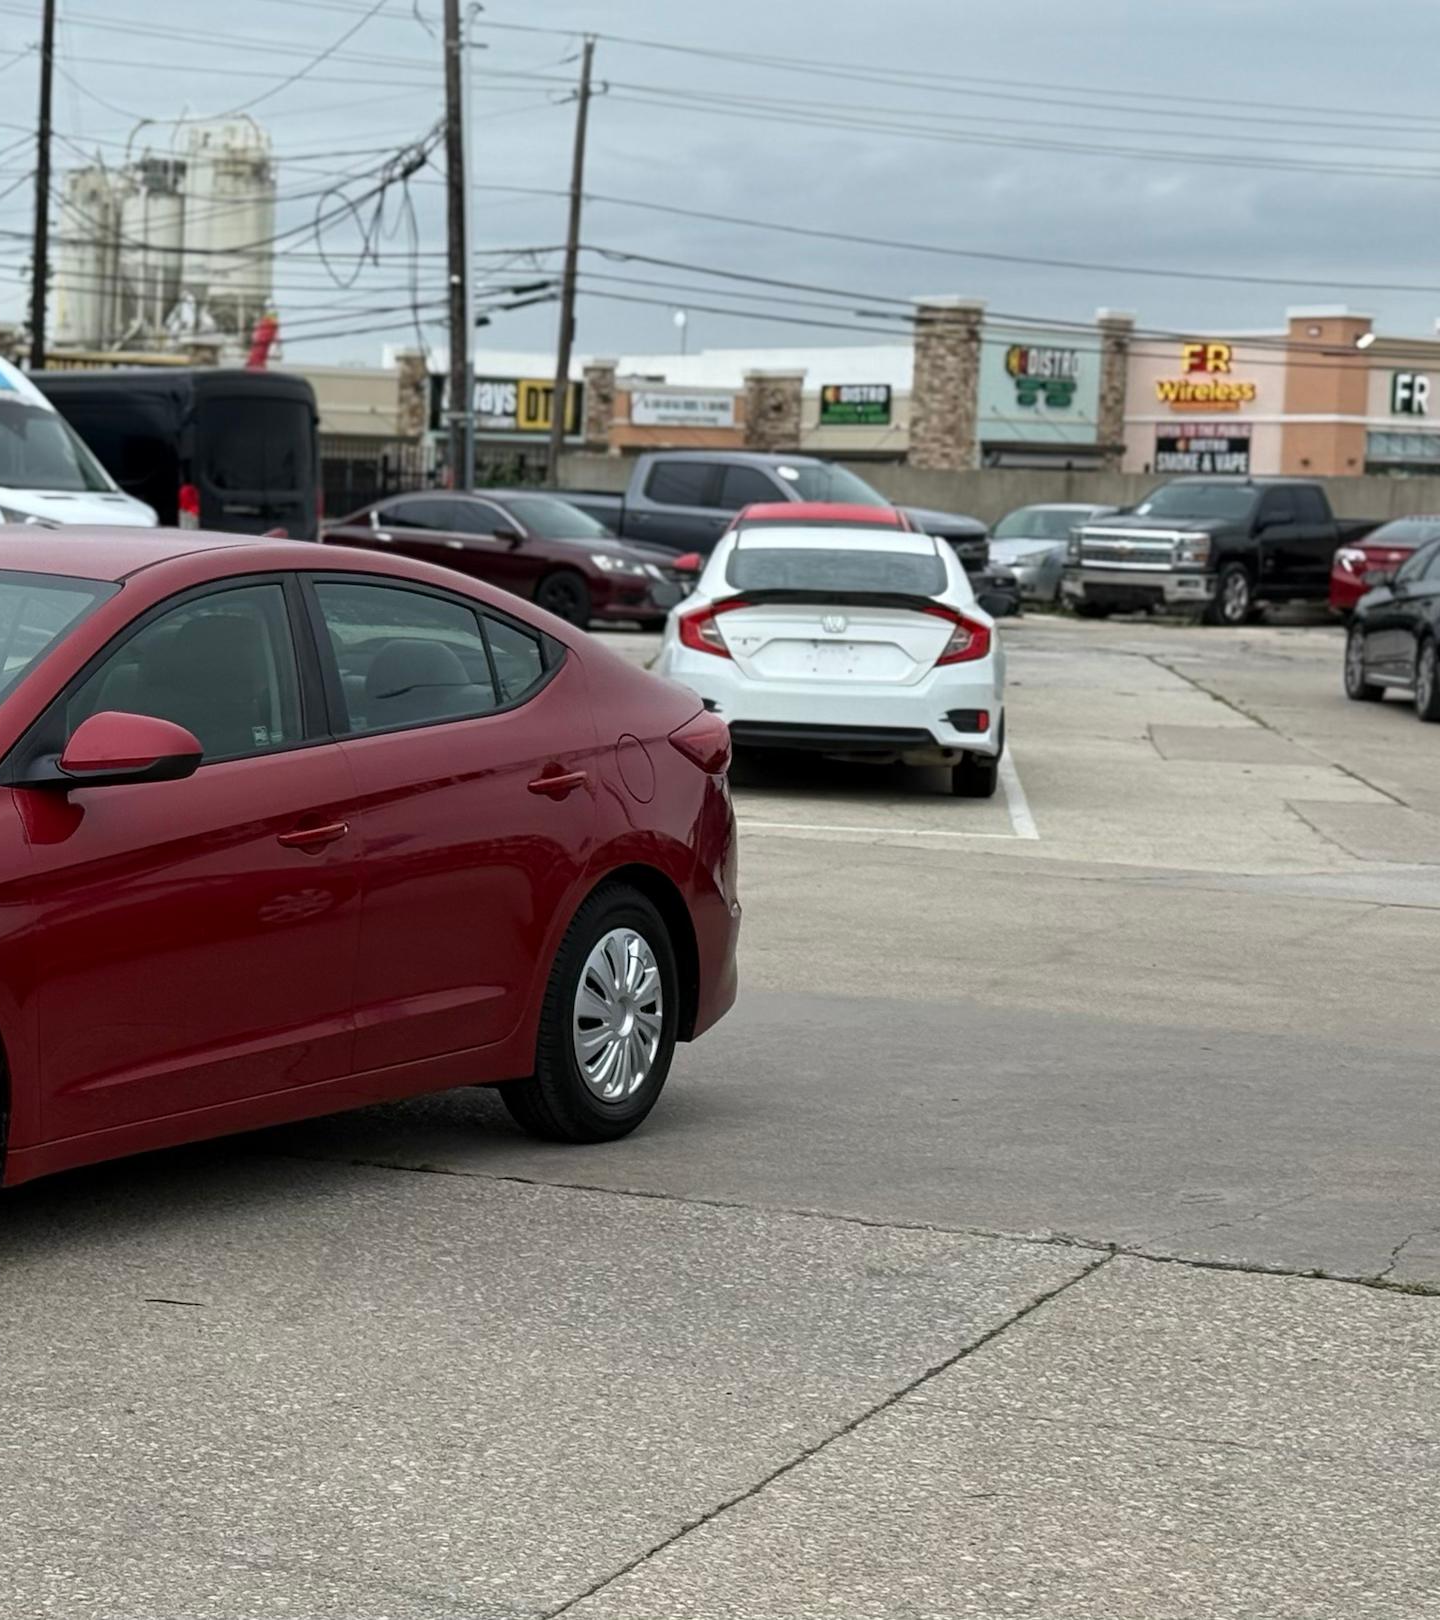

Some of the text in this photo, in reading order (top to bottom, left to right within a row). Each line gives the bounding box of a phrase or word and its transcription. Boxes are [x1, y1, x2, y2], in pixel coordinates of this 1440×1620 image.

[1027, 348, 1079, 376] DISTRO
[1181, 342, 1231, 373] FR
[1156, 378, 1256, 402] Wireless
[1394, 373, 1430, 413] FR
[1157, 452, 1200, 471] SMOKE
[1215, 453, 1249, 472] VAPE
